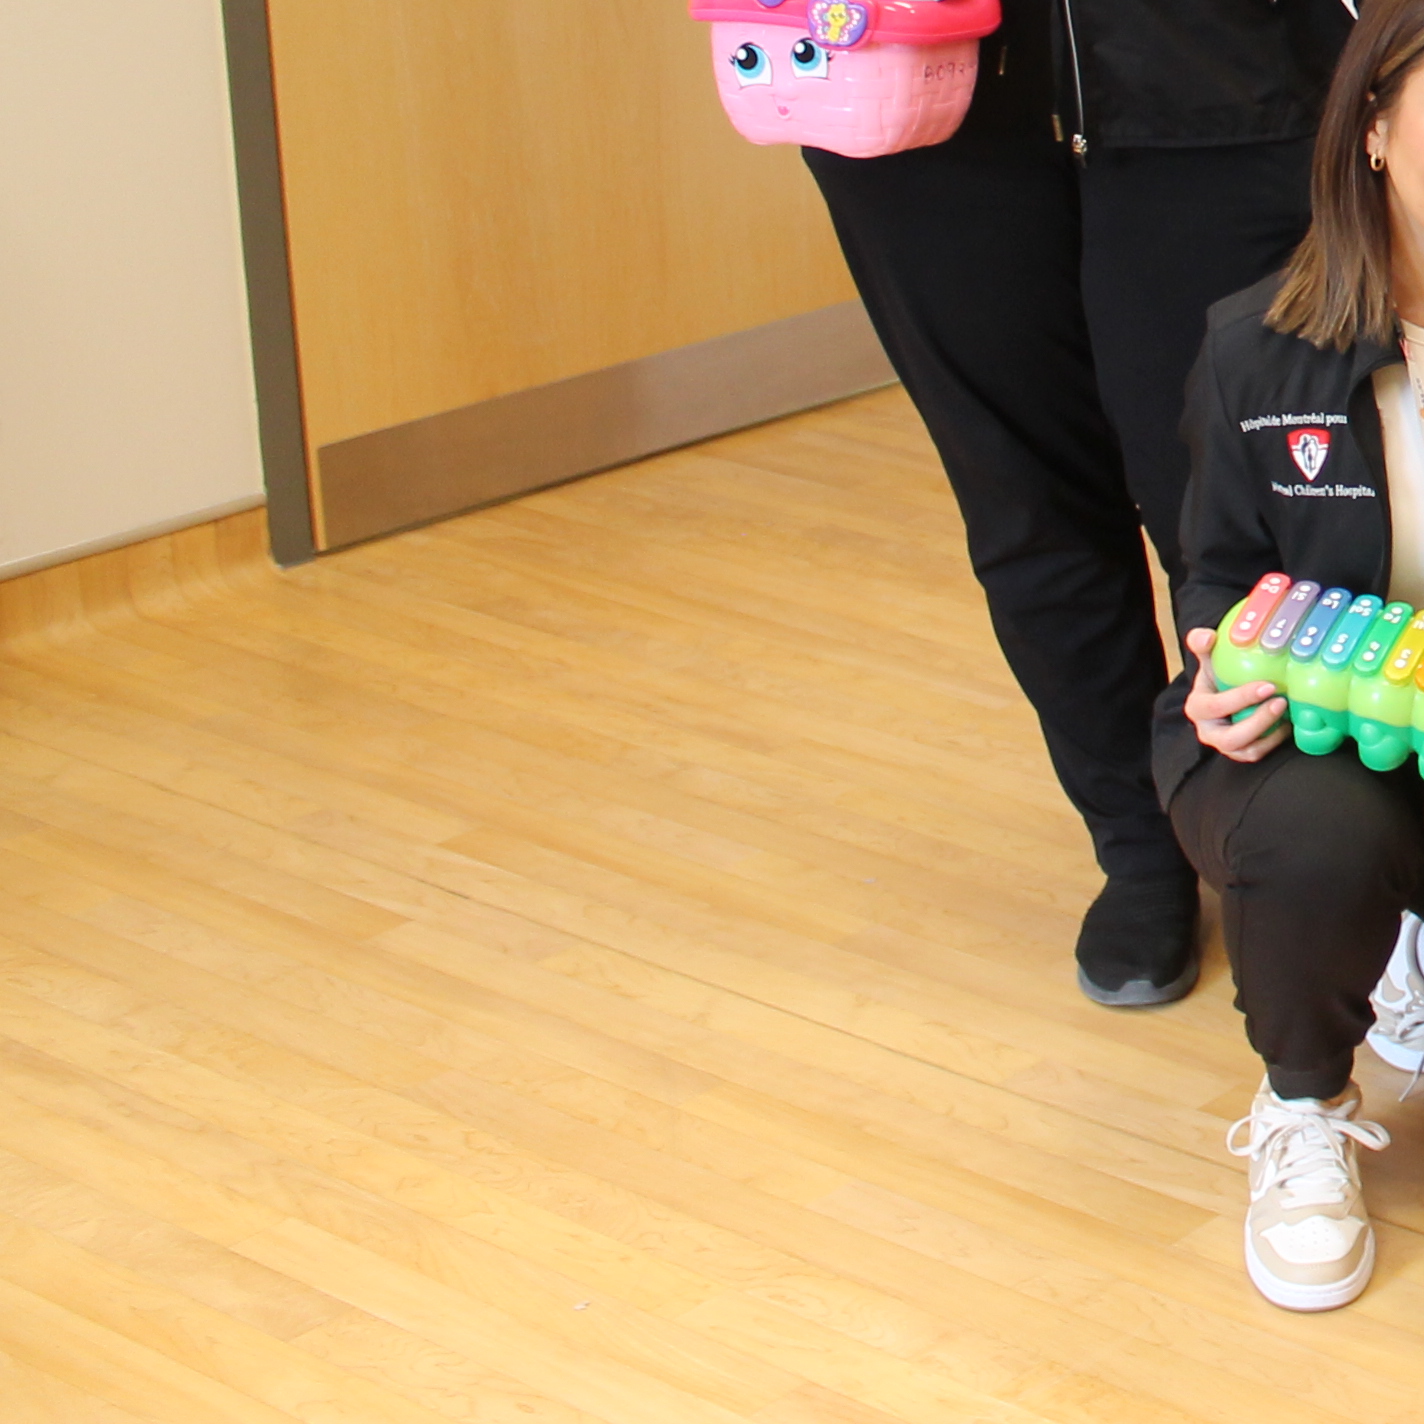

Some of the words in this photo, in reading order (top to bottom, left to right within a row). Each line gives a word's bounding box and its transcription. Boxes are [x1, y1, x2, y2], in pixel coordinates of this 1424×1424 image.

[1348, 604, 1372, 617] Sol
[1276, 619, 1287, 628] 7
[1307, 626, 1318, 636] 6
[1337, 633, 1349, 644] 5
